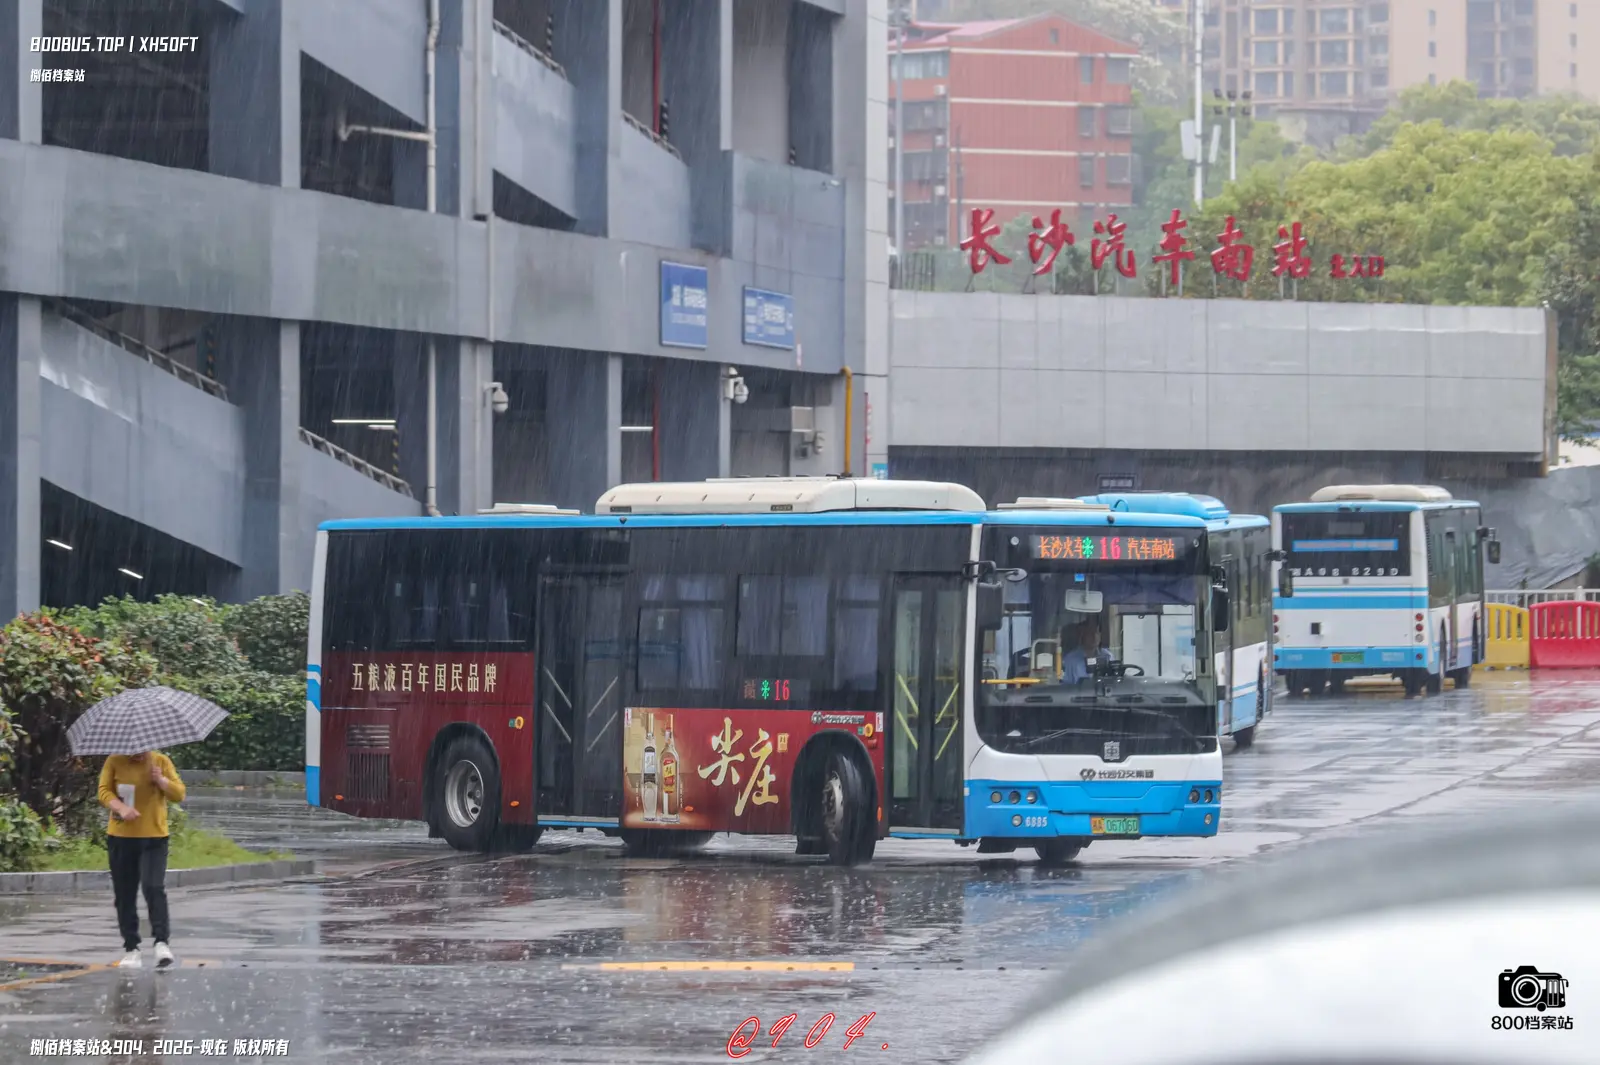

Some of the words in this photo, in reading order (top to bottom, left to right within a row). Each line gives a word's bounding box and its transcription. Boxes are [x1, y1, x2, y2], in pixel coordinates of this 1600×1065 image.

[959, 207, 1312, 285] 长沙汽车南站
[1038, 536, 1083, 559] 长沙火车
[1099, 536, 1122, 559] 16
[1127, 537, 1175, 560] 汽车南站
[351, 662, 497, 693] 五粮液百年国民品牌
[775, 679, 791, 701] 16
[697, 716, 779, 817] 尖庄
